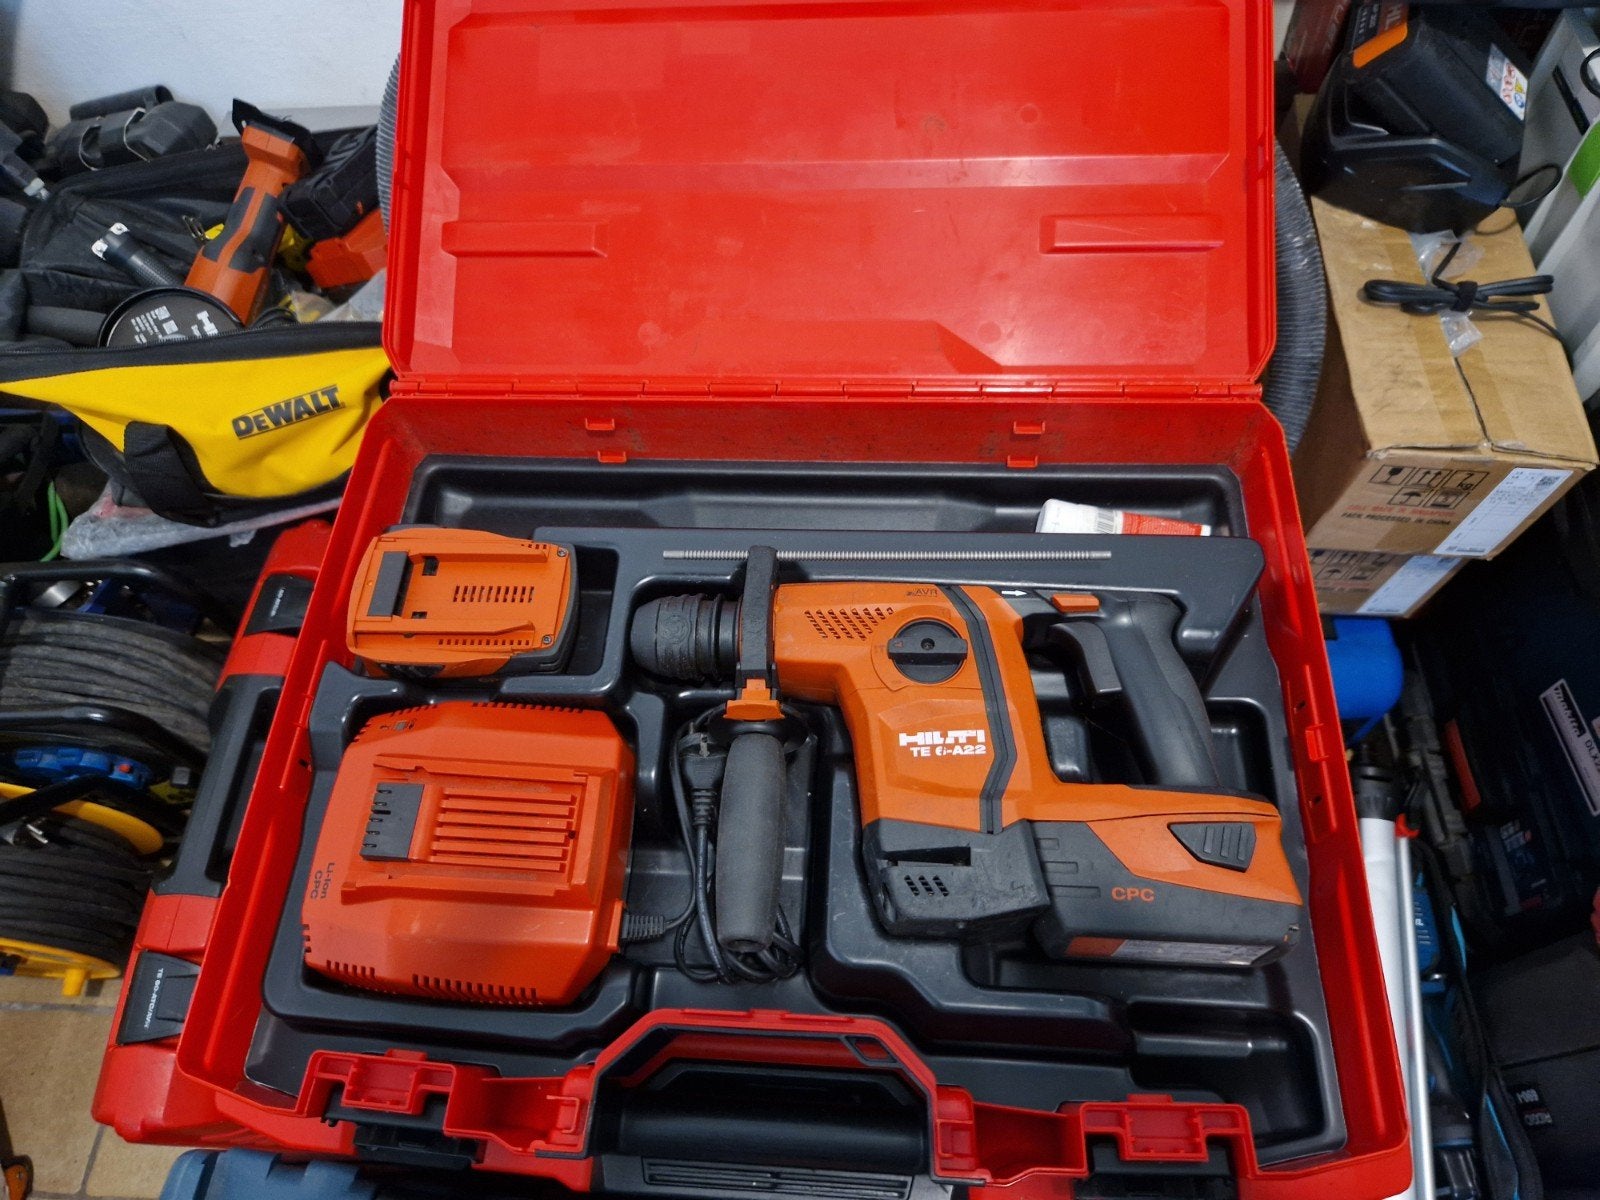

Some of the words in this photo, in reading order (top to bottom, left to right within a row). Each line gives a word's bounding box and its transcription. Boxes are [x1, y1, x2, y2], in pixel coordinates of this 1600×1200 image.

[898, 729, 986, 747] HILTI
[910, 746, 931, 758] TE
[310, 870, 323, 899] CPC
[1111, 886, 1155, 902] CPC
